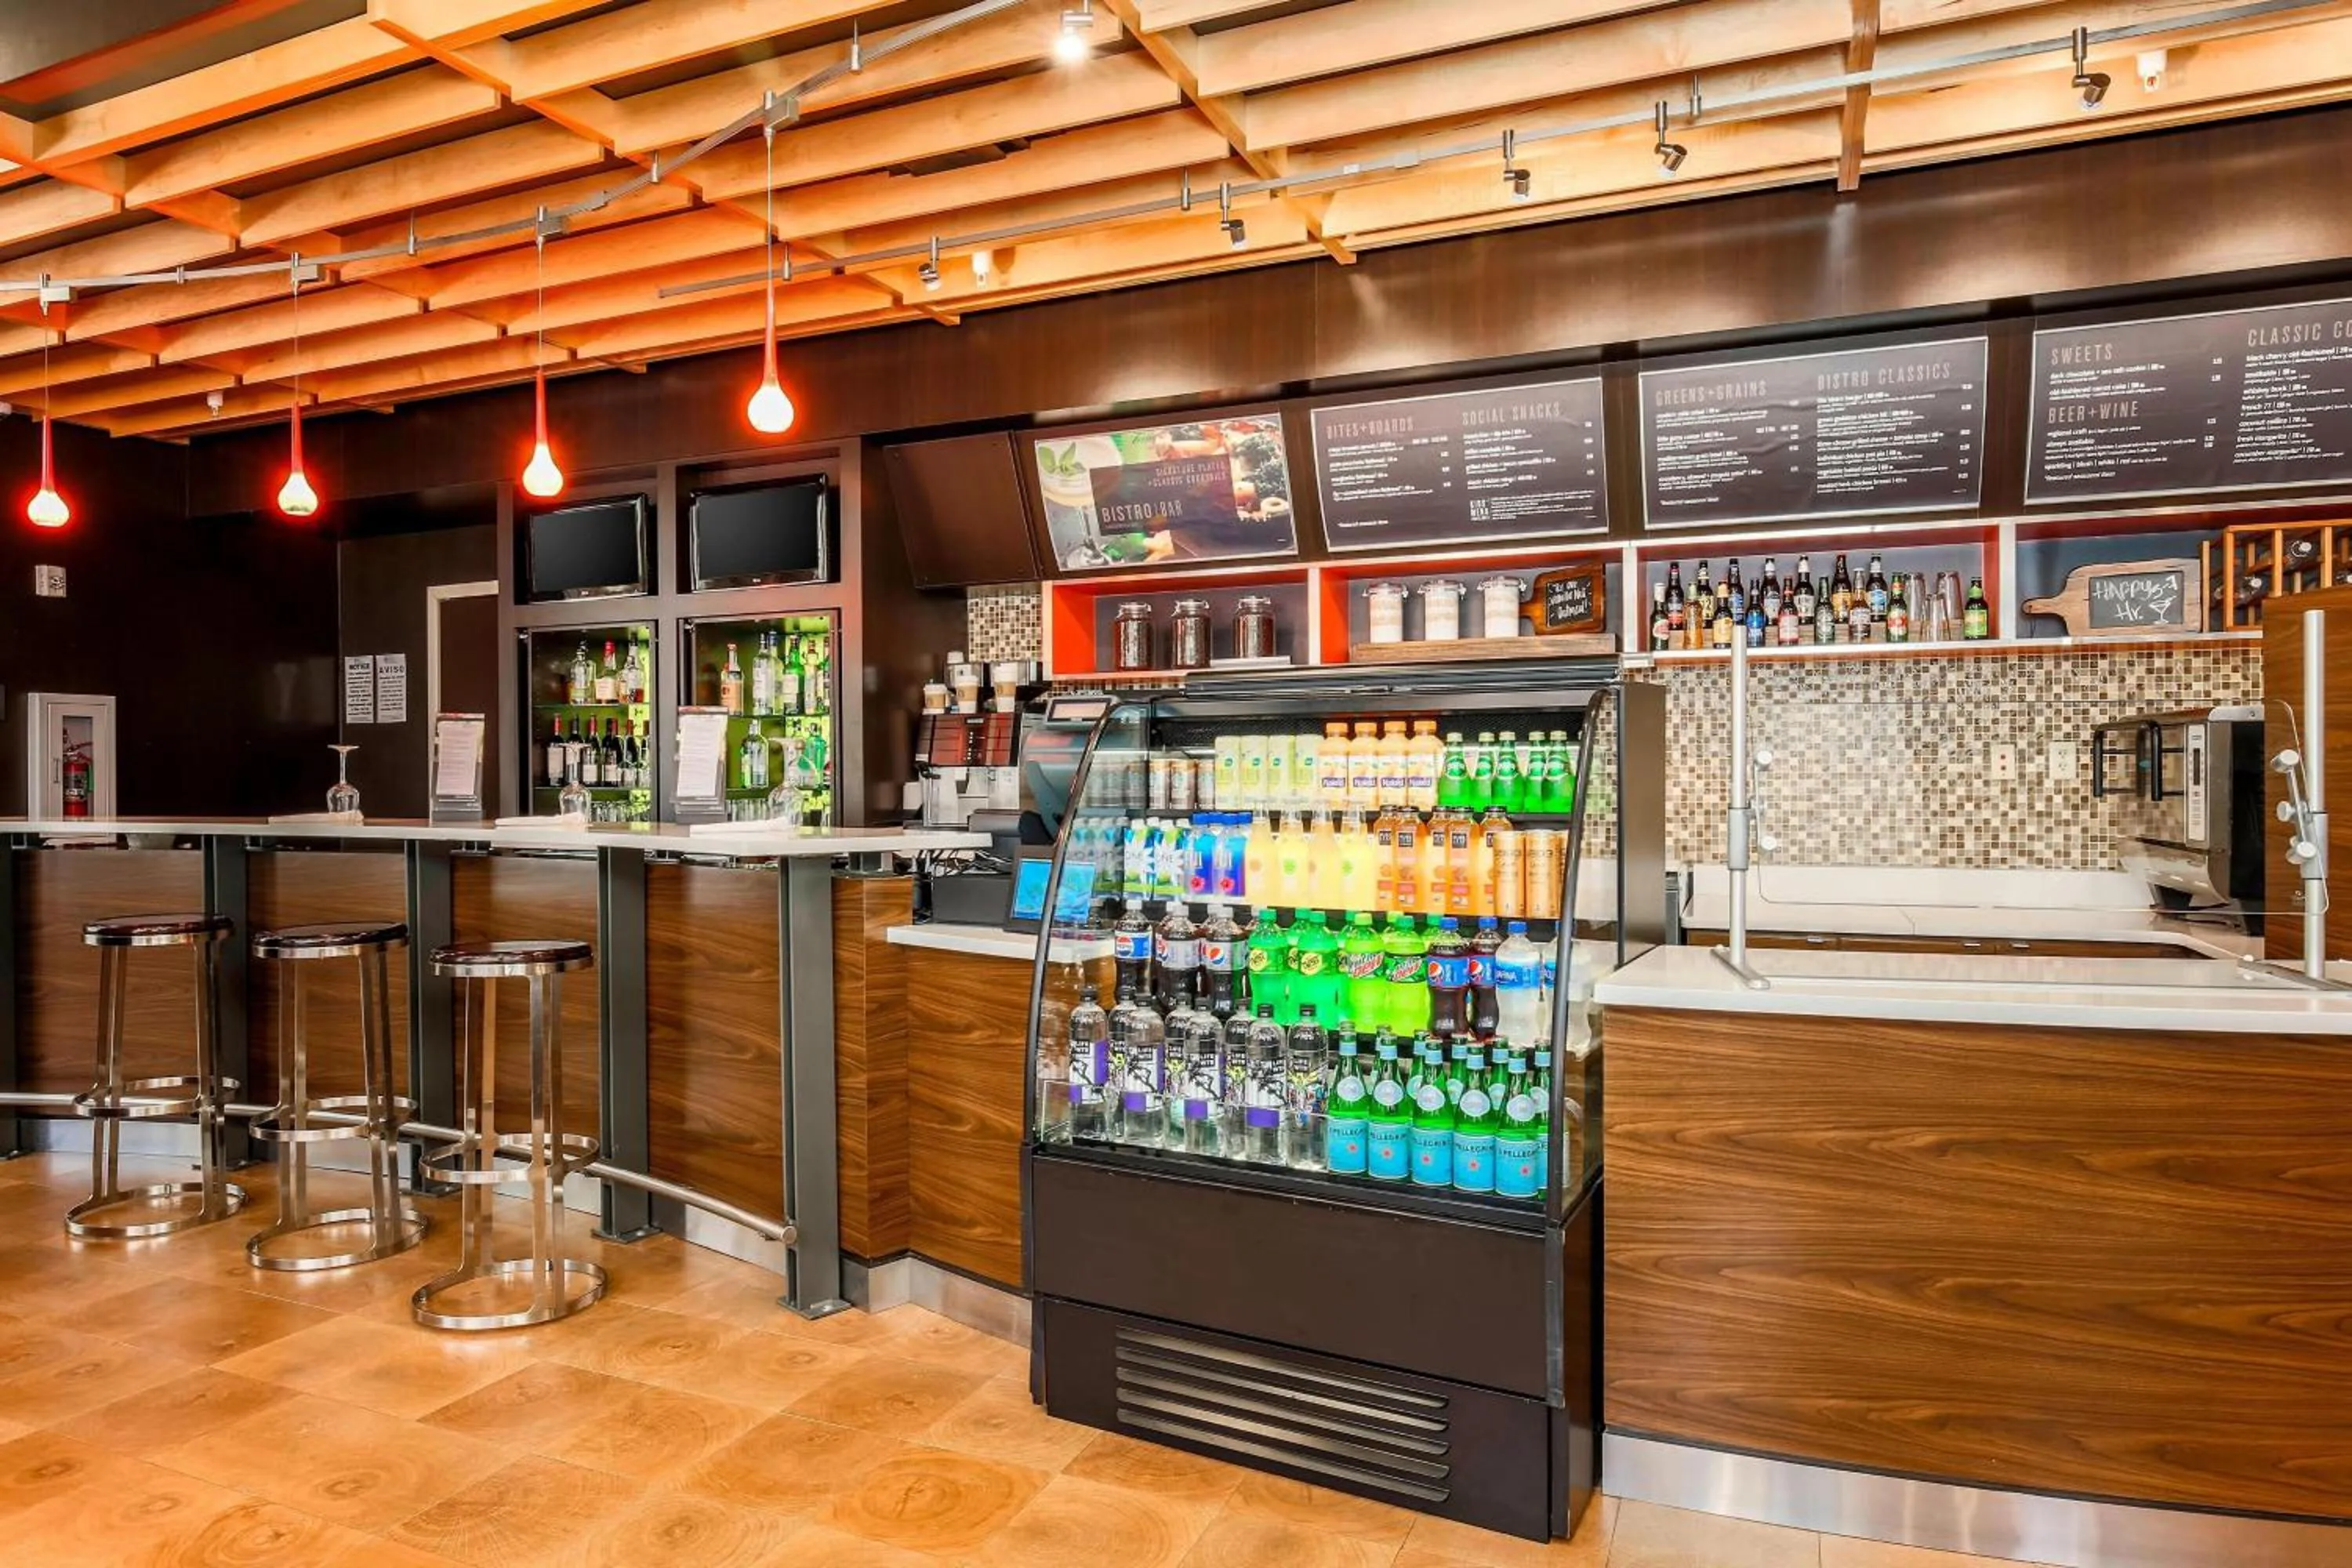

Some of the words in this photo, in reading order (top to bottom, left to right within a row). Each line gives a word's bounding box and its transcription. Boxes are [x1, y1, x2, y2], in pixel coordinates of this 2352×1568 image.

[2248, 323, 2321, 347] CLASSIC
[2051, 343, 2114, 365] SWEETS
[1817, 371, 1869, 390] BISTRO
[1878, 363, 1951, 385] CLASSICS
[1462, 407, 1505, 426] SOCIAL
[1512, 401, 1560, 421] SNACKS
[1102, 503, 1152, 523] BISTRO
[1160, 499, 1184, 517] BAR
